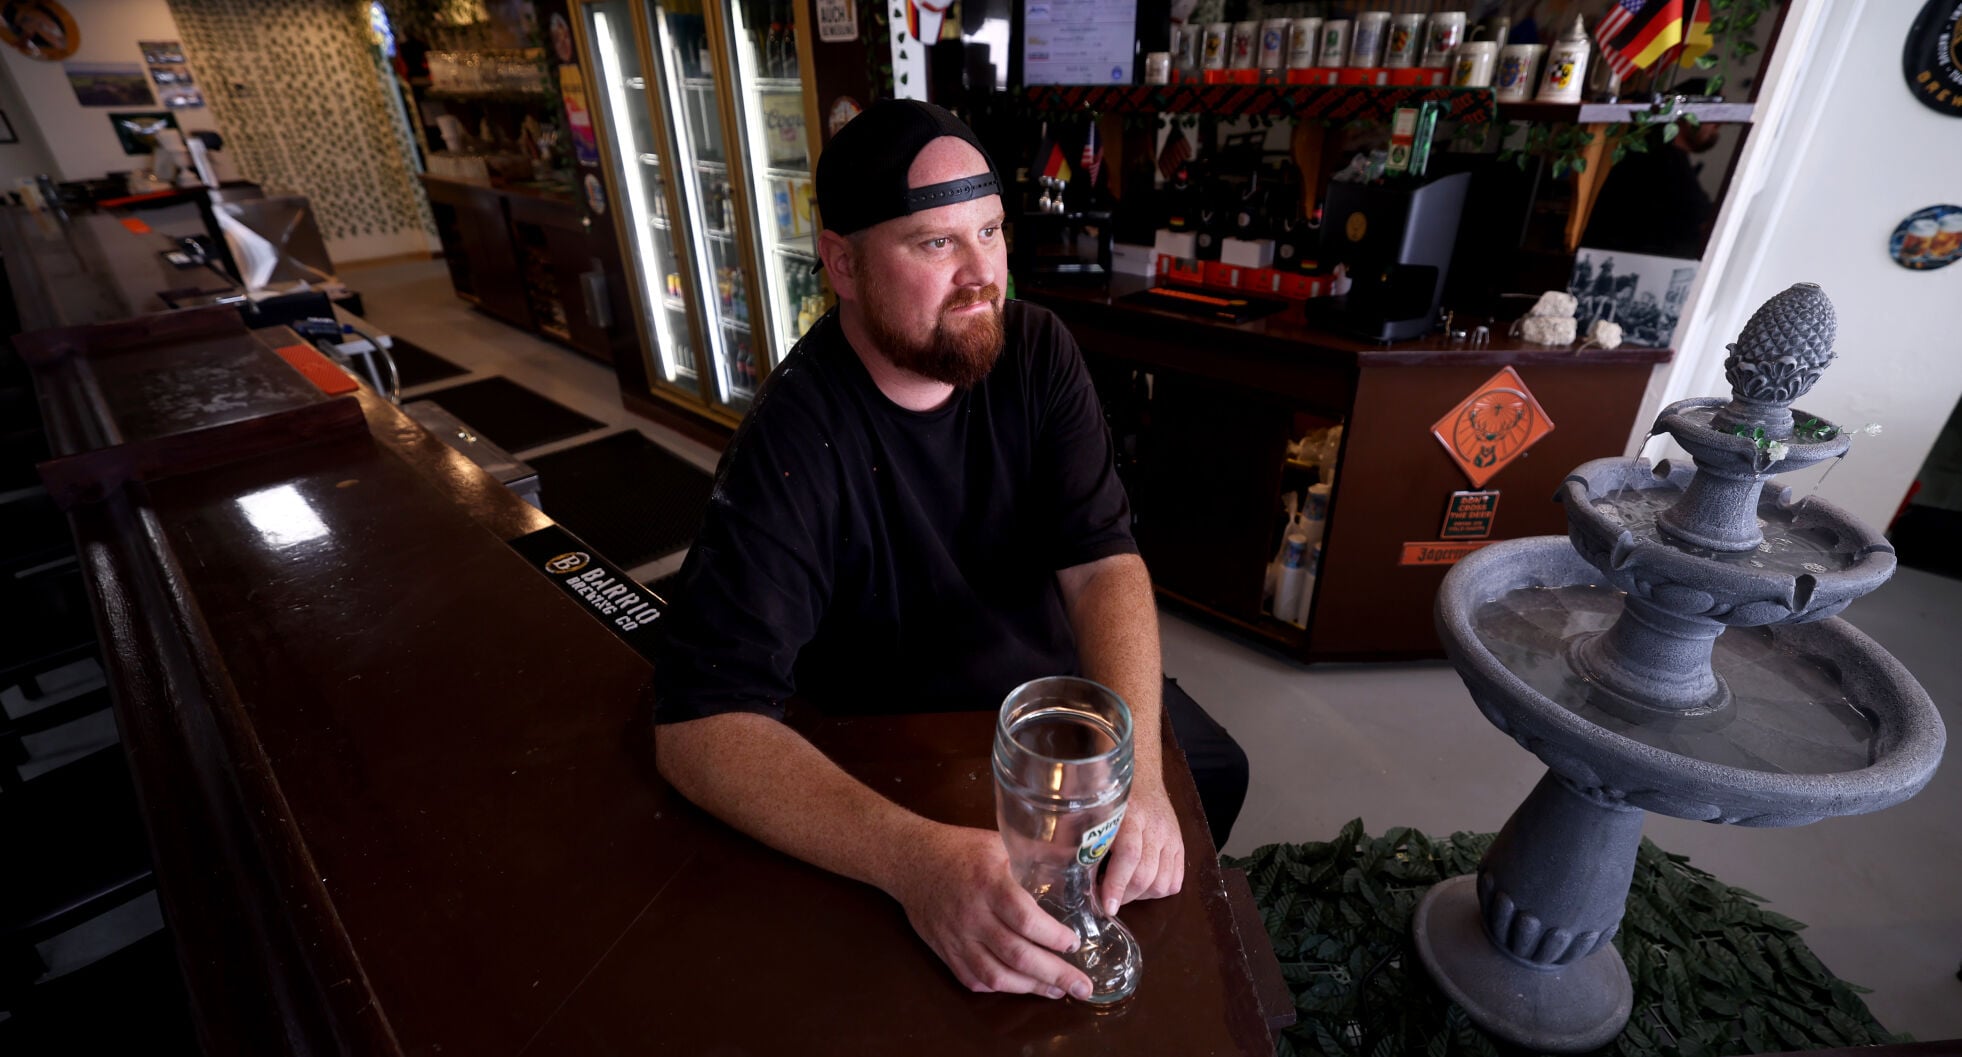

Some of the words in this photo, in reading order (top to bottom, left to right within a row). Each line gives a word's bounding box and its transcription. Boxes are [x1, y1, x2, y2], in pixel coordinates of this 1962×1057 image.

[553, 555, 580, 570] B
[565, 576, 618, 615] BREWING
[615, 615, 638, 631] CO
[580, 567, 661, 625] BARRIO
